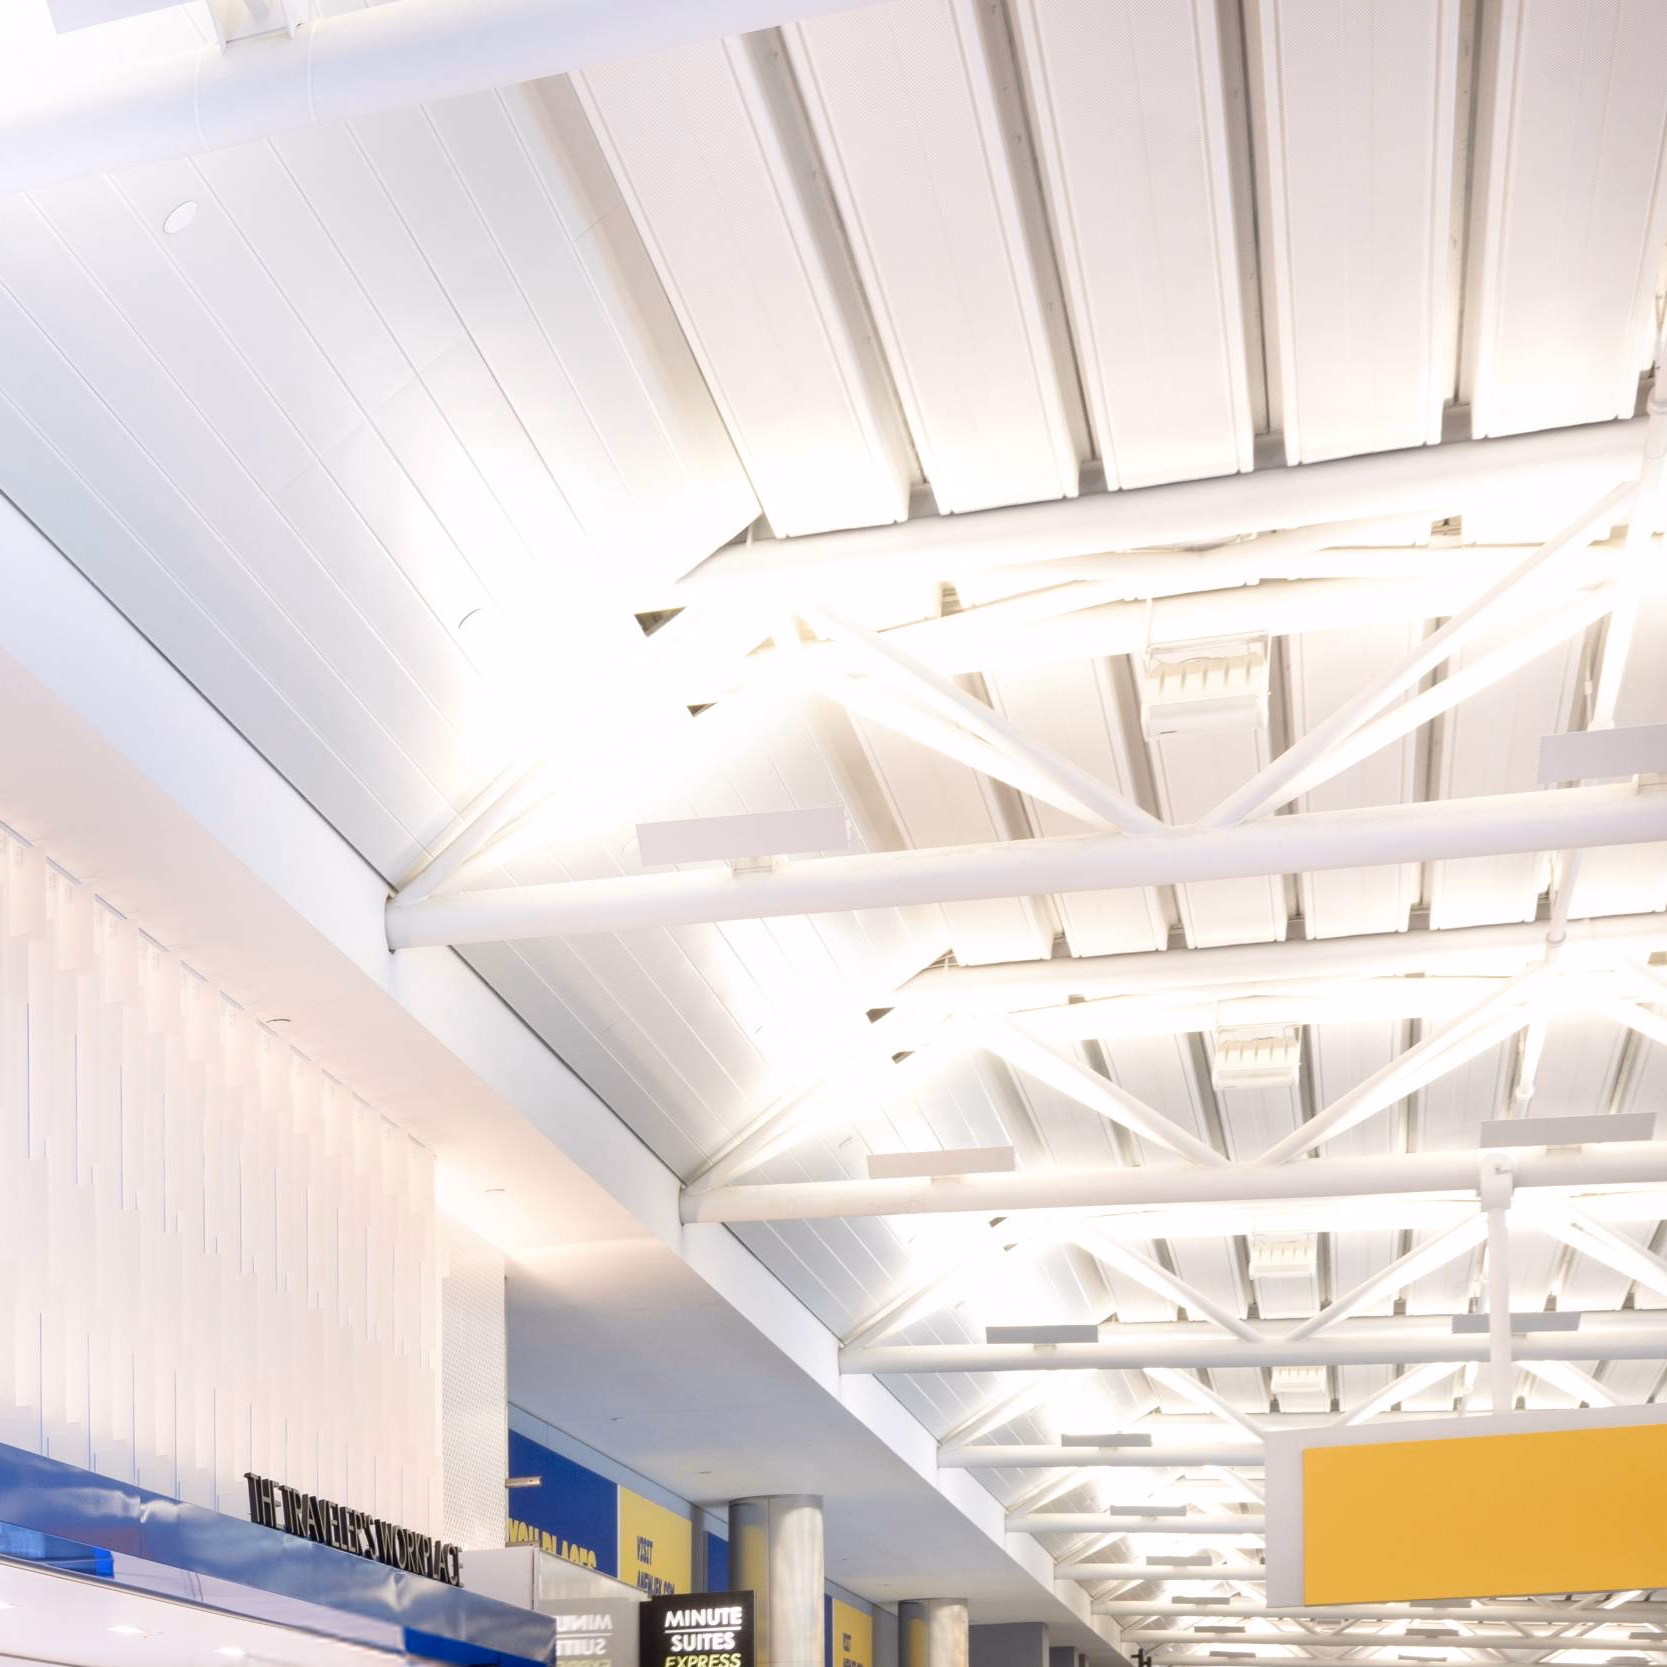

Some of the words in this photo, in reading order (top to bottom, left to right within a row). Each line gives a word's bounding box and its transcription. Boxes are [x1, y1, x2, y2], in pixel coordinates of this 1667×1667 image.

[244, 1472, 282, 1530] THE
[279, 1485, 377, 1560] TRAVELER'S
[375, 1519, 464, 1587] WORKPLACE
[664, 1606, 742, 1628] MINUTE
[670, 1631, 736, 1652] SUITES
